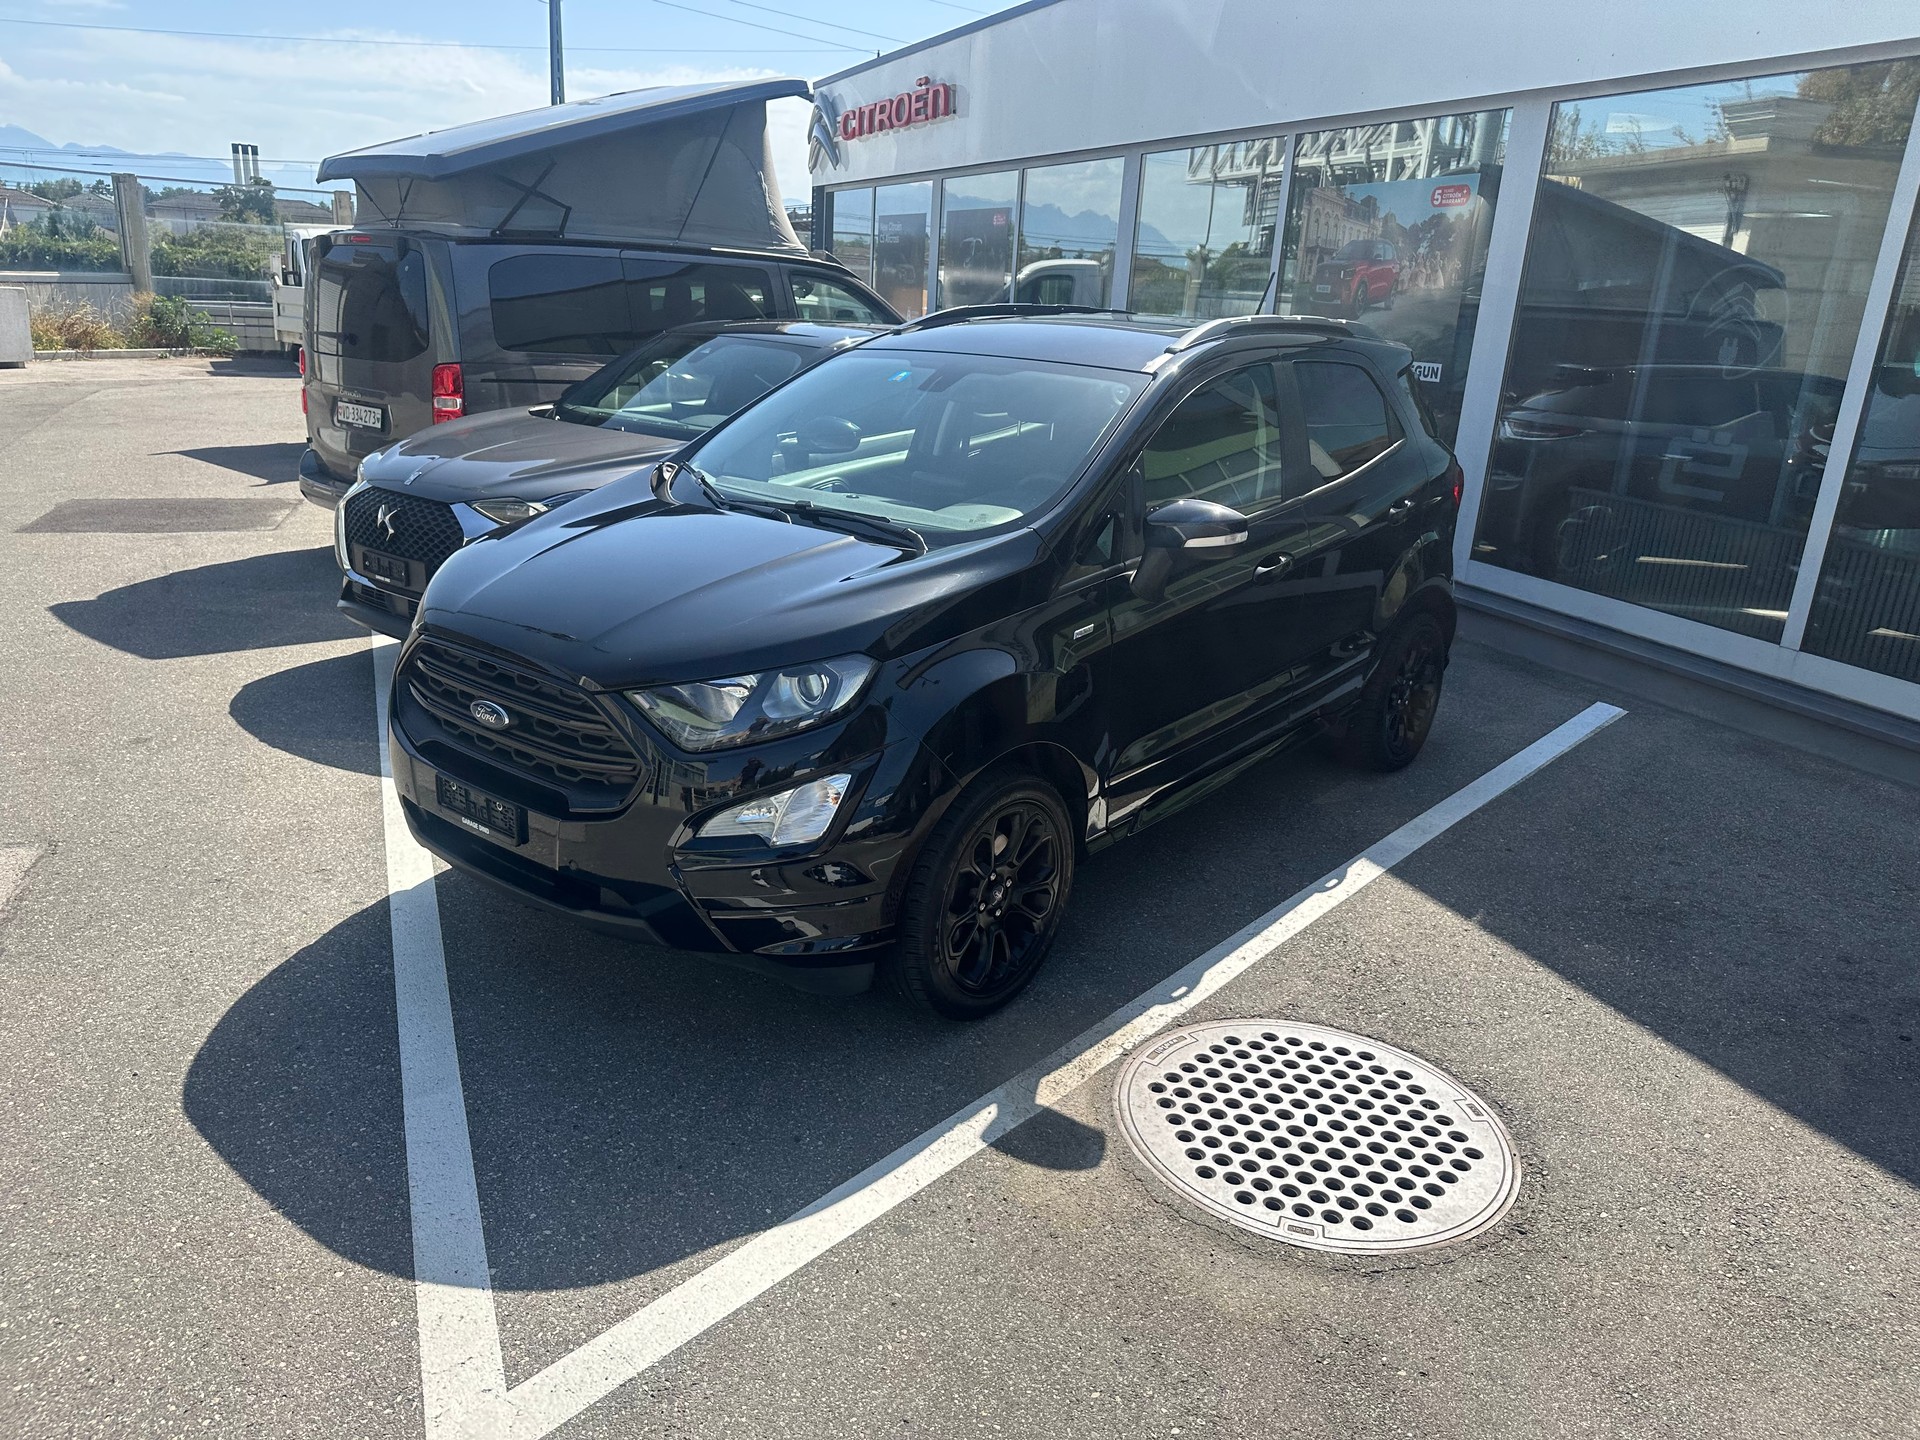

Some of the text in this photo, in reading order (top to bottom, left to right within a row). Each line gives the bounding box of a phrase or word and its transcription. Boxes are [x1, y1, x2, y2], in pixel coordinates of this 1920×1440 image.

[1433, 189, 1442, 205] 5
[1411, 364, 1439, 379] GUN
[475, 704, 497, 723] Ford
